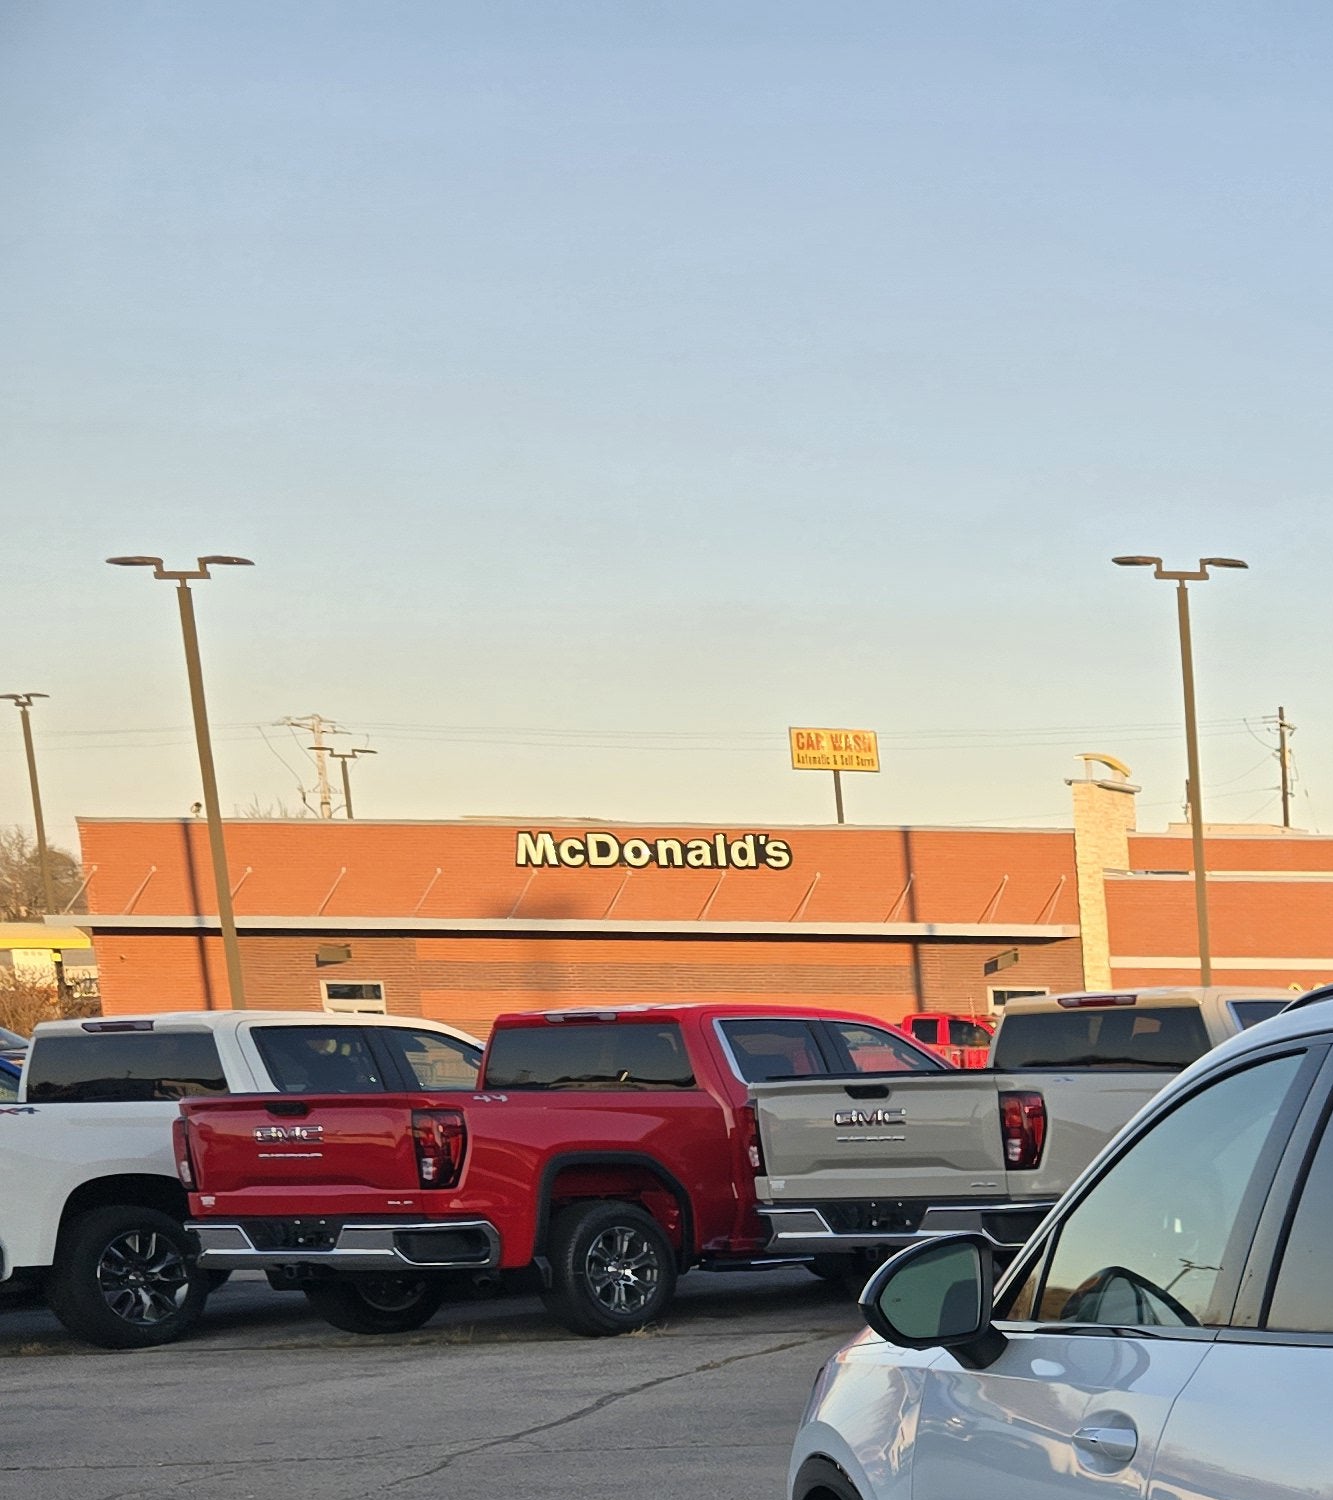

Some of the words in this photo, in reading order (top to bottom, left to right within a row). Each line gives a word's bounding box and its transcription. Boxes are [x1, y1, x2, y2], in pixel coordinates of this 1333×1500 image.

[796, 732, 824, 750] CAR
[830, 733, 872, 753] WASH
[516, 831, 792, 869] McDonald's
[834, 1108, 906, 1126] GMC
[255, 1125, 323, 1144] GMC
